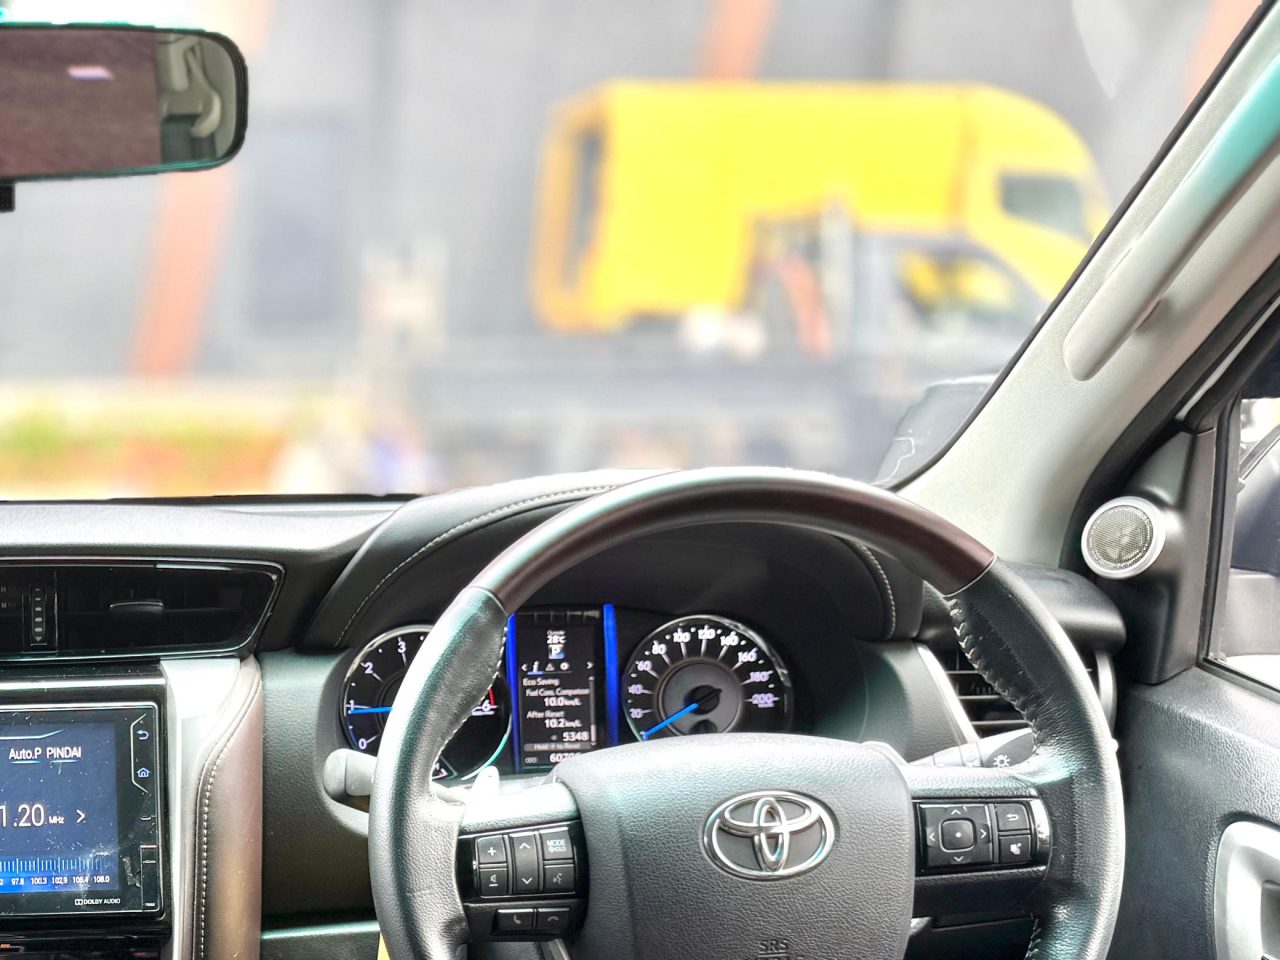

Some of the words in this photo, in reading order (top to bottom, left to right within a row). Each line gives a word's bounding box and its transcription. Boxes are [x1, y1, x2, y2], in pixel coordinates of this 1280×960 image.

[398, 641, 406, 653] 3
[365, 662, 373, 674] 2
[482, 700, 491, 711] 6
[562, 732, 589, 741] 5348
[359, 738, 367, 749] 0
[46, 746, 82, 759] PINDAI
[49, 816, 65, 825] MHz
[759, 940, 790, 952] SRS
